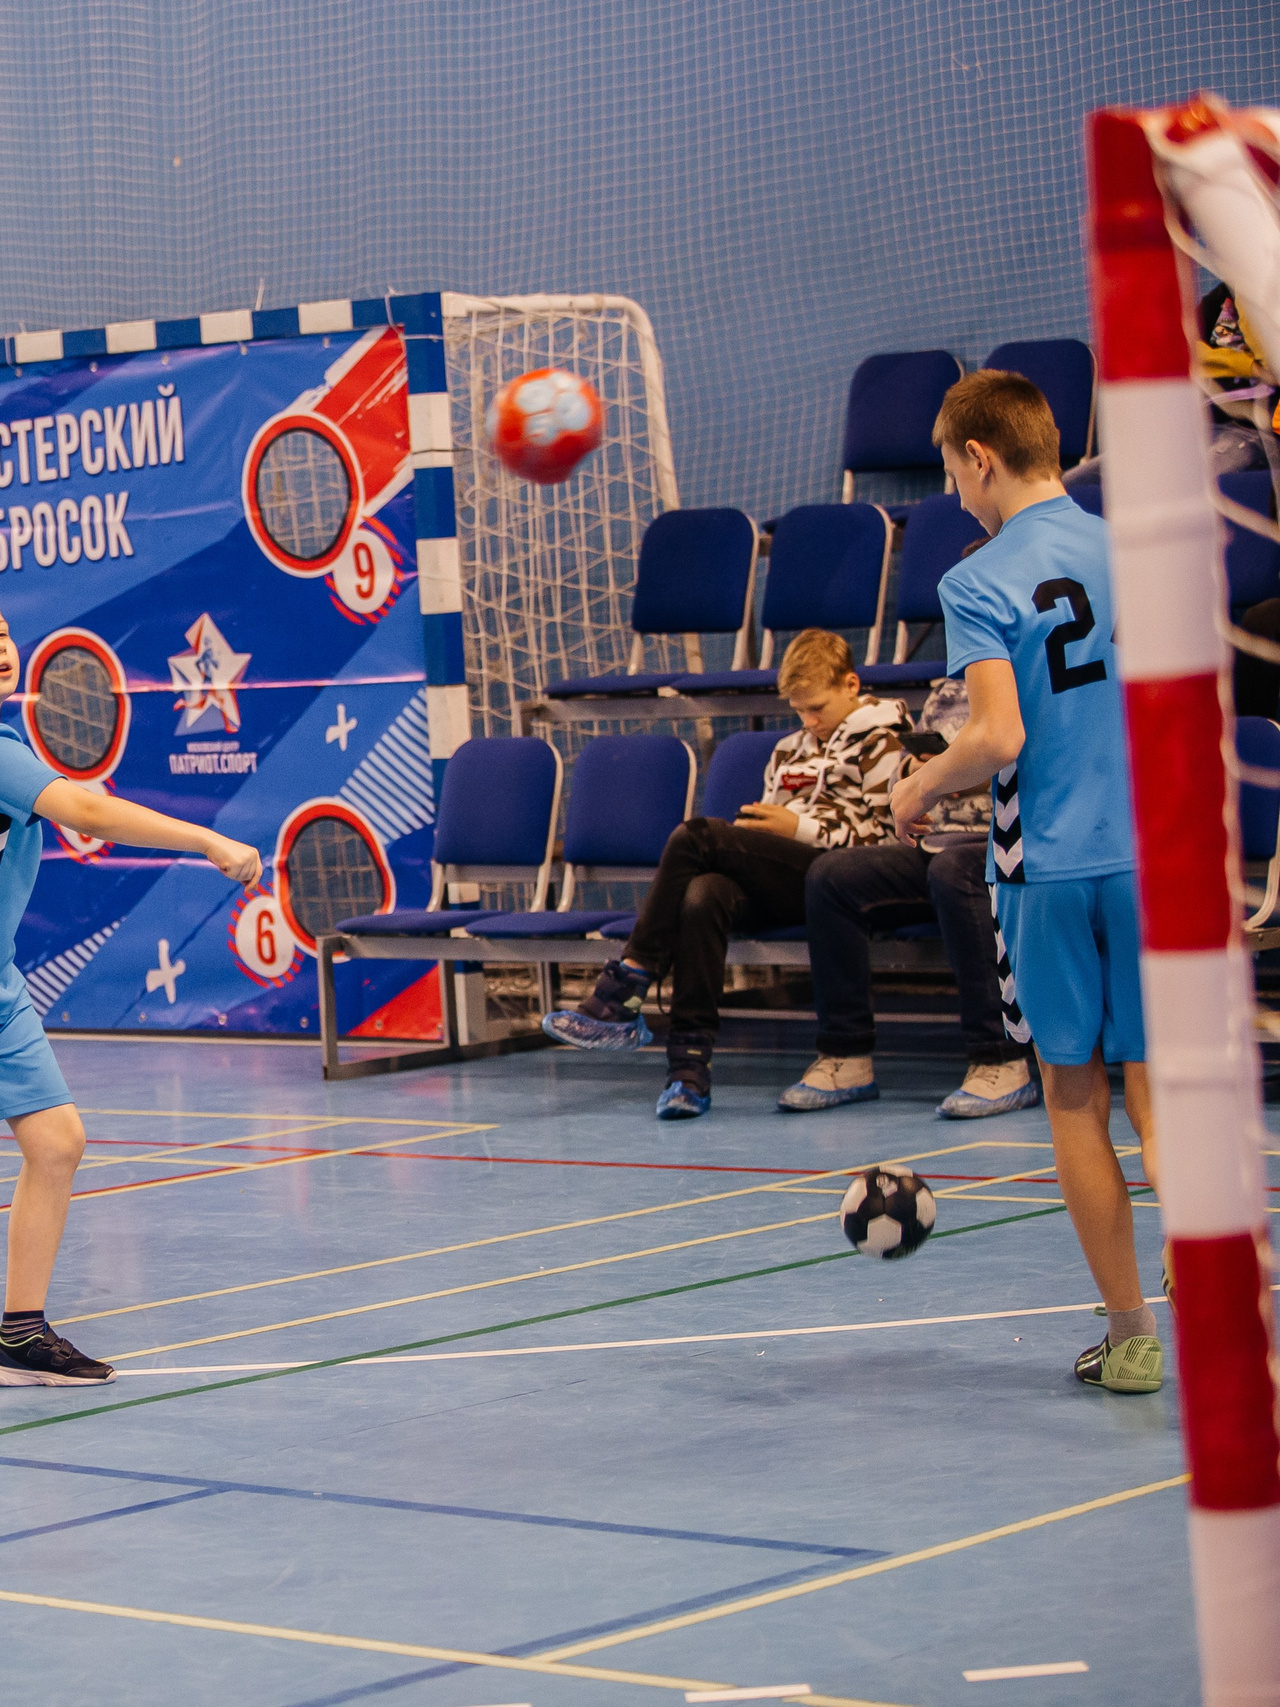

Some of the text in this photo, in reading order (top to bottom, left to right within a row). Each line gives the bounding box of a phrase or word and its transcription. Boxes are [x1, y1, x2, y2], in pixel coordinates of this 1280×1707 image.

[352, 542, 376, 600] 9
[1030, 576, 1118, 695] 2
[256, 909, 277, 966] 6
